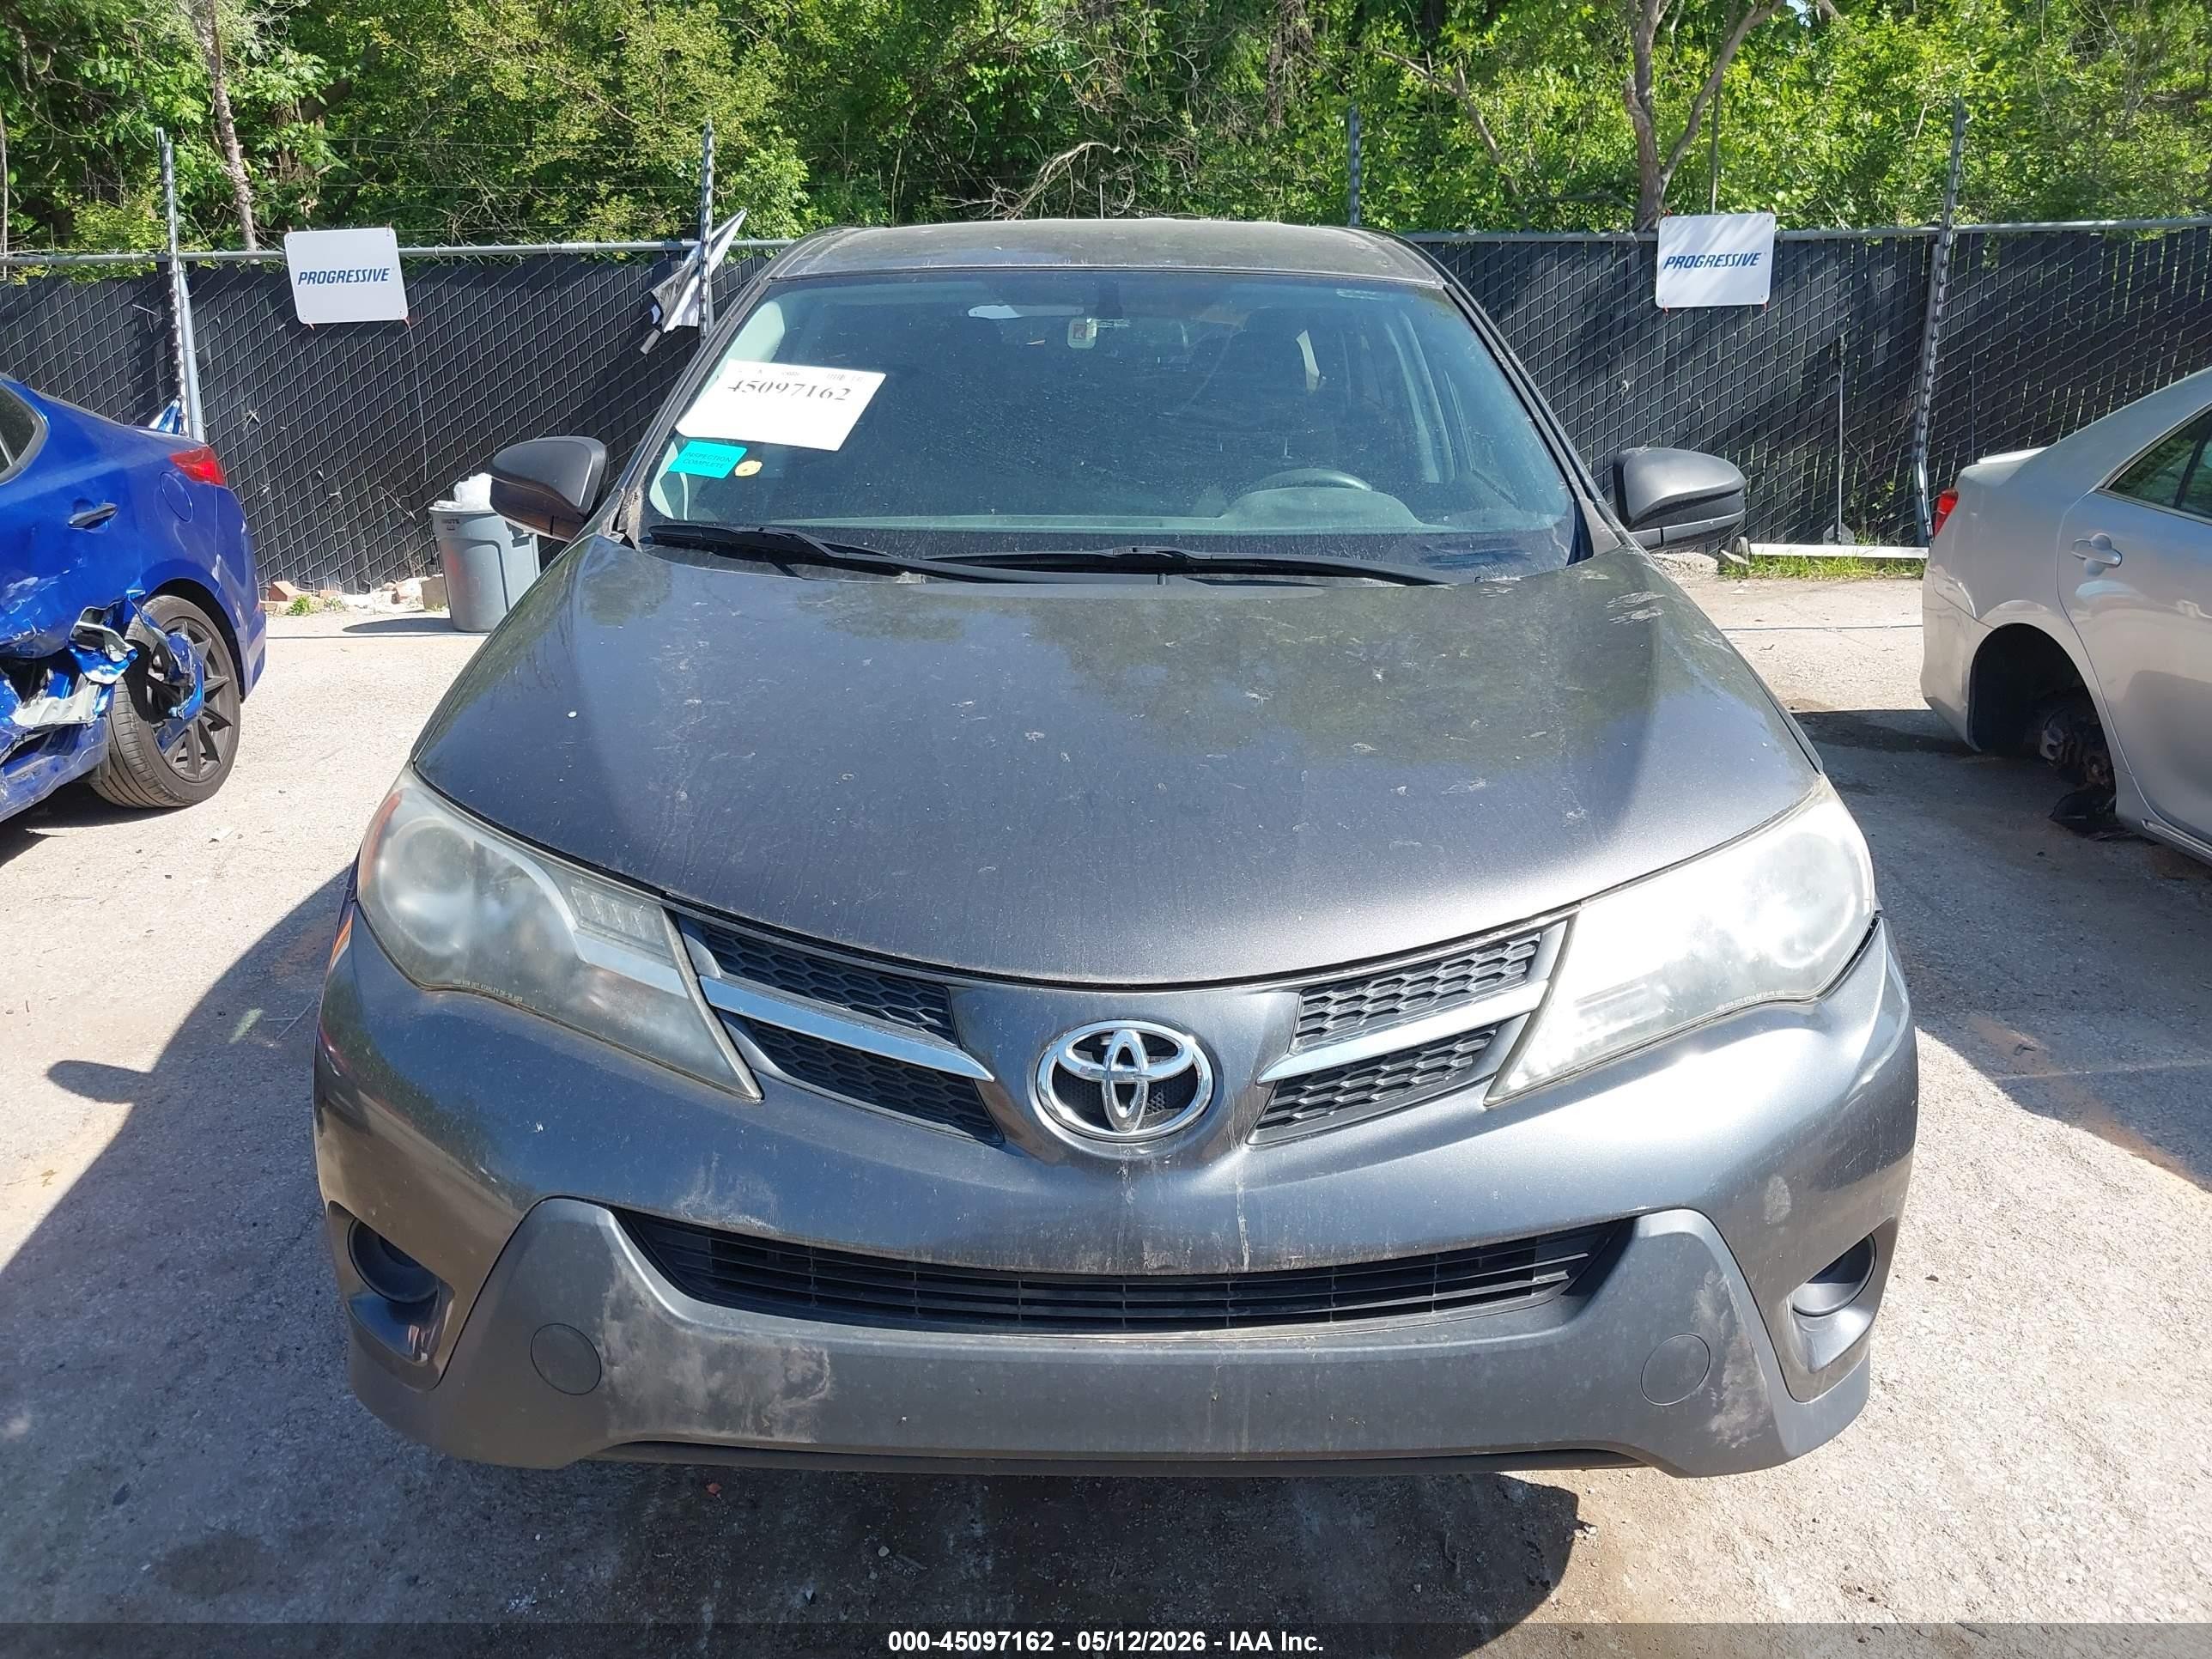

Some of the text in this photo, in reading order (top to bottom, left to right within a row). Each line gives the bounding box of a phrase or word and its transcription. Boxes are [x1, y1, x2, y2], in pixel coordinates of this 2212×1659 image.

[1663, 252, 1762, 270] PROGRESSIVE
[297, 268, 390, 285] PROGRESSIVE
[728, 379, 852, 401] 45097162
[683, 459, 726, 469] COMPLETE
[684, 452, 732, 463] INSPECTION
